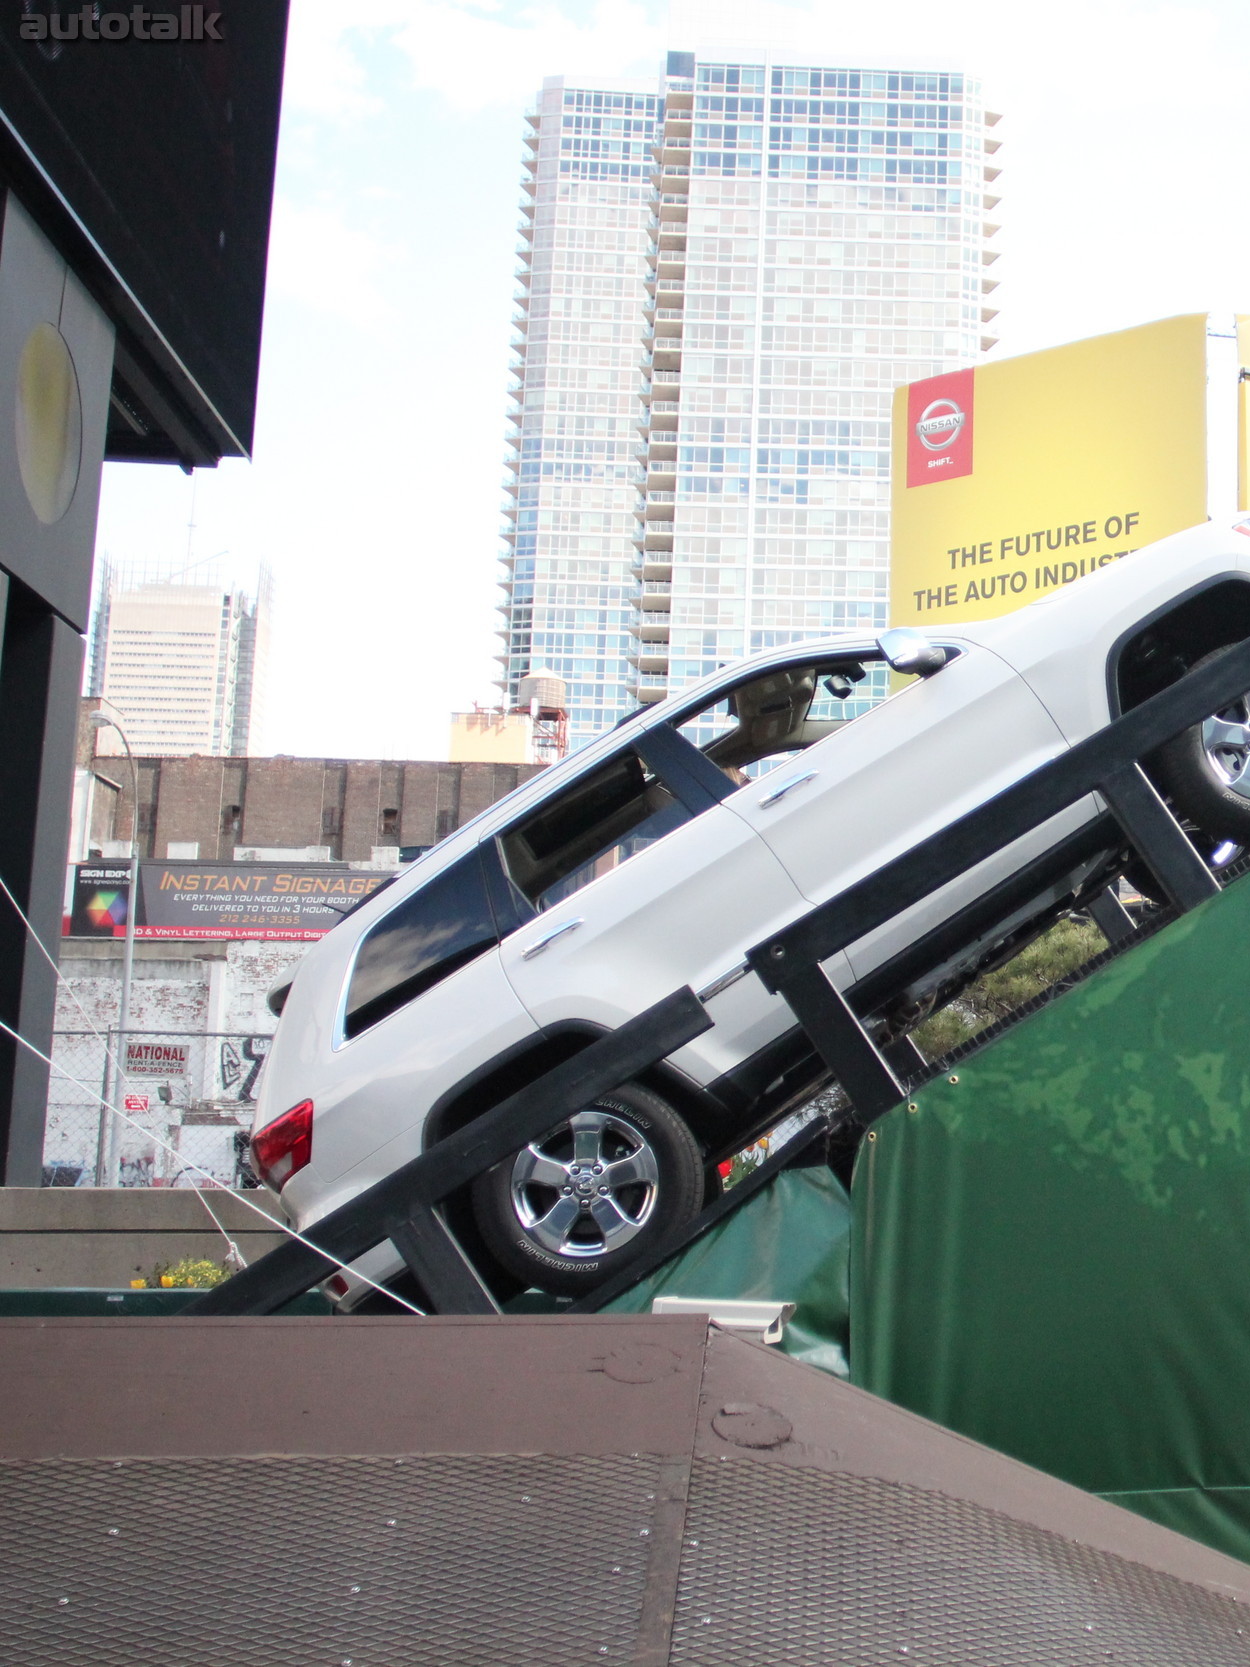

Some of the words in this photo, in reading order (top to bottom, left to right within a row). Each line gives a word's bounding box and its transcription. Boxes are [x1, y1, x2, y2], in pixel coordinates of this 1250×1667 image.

[920, 416, 961, 433] NISSAN
[947, 542, 993, 570] THE
[1000, 520, 1097, 560] FUTURE
[1104, 511, 1140, 539] OF
[913, 585, 958, 611] THE
[964, 571, 1027, 603] AUTO
[160, 871, 267, 892] INSTANT
[272, 874, 382, 894] SIGNAGE
[174, 894, 231, 902] EVERYTHING
[300, 896, 326, 904] YOUR
[327, 897, 359, 905] BOOTH
[192, 904, 243, 912] DELIVERED
[261, 905, 280, 913] YOU
[292, 904, 301, 914] 3
[302, 906, 335, 914] HOURS
[219, 914, 239, 923] 212
[155, 928, 180, 936] VINYL
[183, 929, 233, 938] LETTERING,
[235, 930, 265, 938] LARGE
[266, 930, 301, 938] OUTPUT
[127, 1045, 185, 1061] NATIONAL
